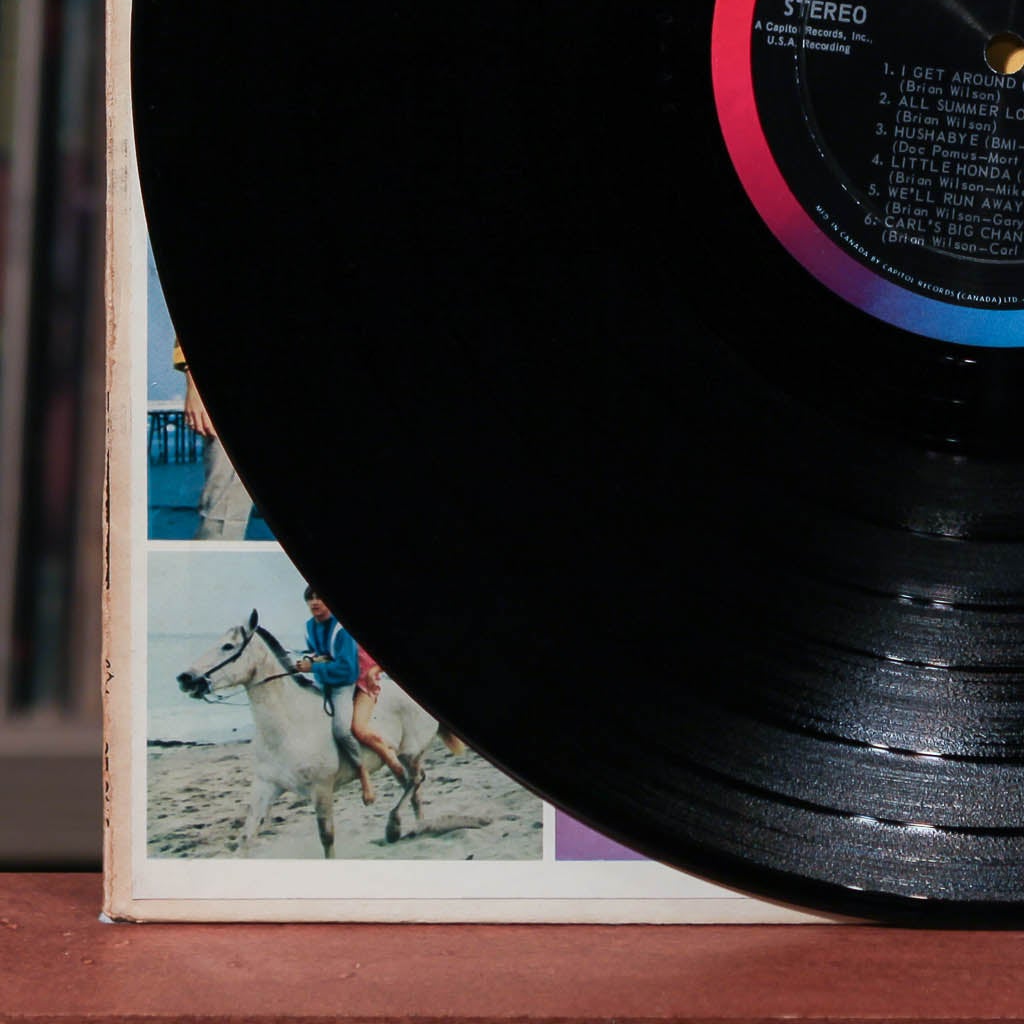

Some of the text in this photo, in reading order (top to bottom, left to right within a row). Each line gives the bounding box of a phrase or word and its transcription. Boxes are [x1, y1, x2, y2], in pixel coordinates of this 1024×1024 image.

[754, 20, 763, 30] A
[805, 25, 847, 41] Records,
[802, 39, 851, 55] Recording
[883, 62, 894, 76] 1.
[901, 64, 906, 76] I
[913, 66, 945, 81] GET
[951, 71, 1017, 89] AROUND
[900, 79, 1001, 103] (Brian Wilson)
[879, 92, 891, 105] 2.
[898, 95, 929, 110] ALL
[937, 98, 999, 117] SUMMER
[875, 122, 887, 135] 3.
[894, 125, 979, 146] HUSHABYE
[896, 110, 997, 134] (Brian Wilson)
[892, 140, 926, 154] (Doc
[871, 153, 884, 166] 4.
[891, 156, 951, 174] LITTLE
[956, 163, 1011, 180] HONDA
[889, 170, 932, 186] (Brian
[868, 183, 880, 196] 5.
[888, 186, 935, 203] WE'LL
[943, 192, 975, 208] RUN
[981, 197, 1024, 213] AWAY
[885, 201, 929, 216] (Brian
[881, 230, 925, 246] (Brian
[884, 216, 942, 233] CARL'S
[948, 223, 974, 237] BIG
[839, 231, 869, 257] CANADA
[870, 255, 881, 264] BY
[882, 263, 914, 283] CAPITOL
[917, 280, 955, 296] RECORDS
